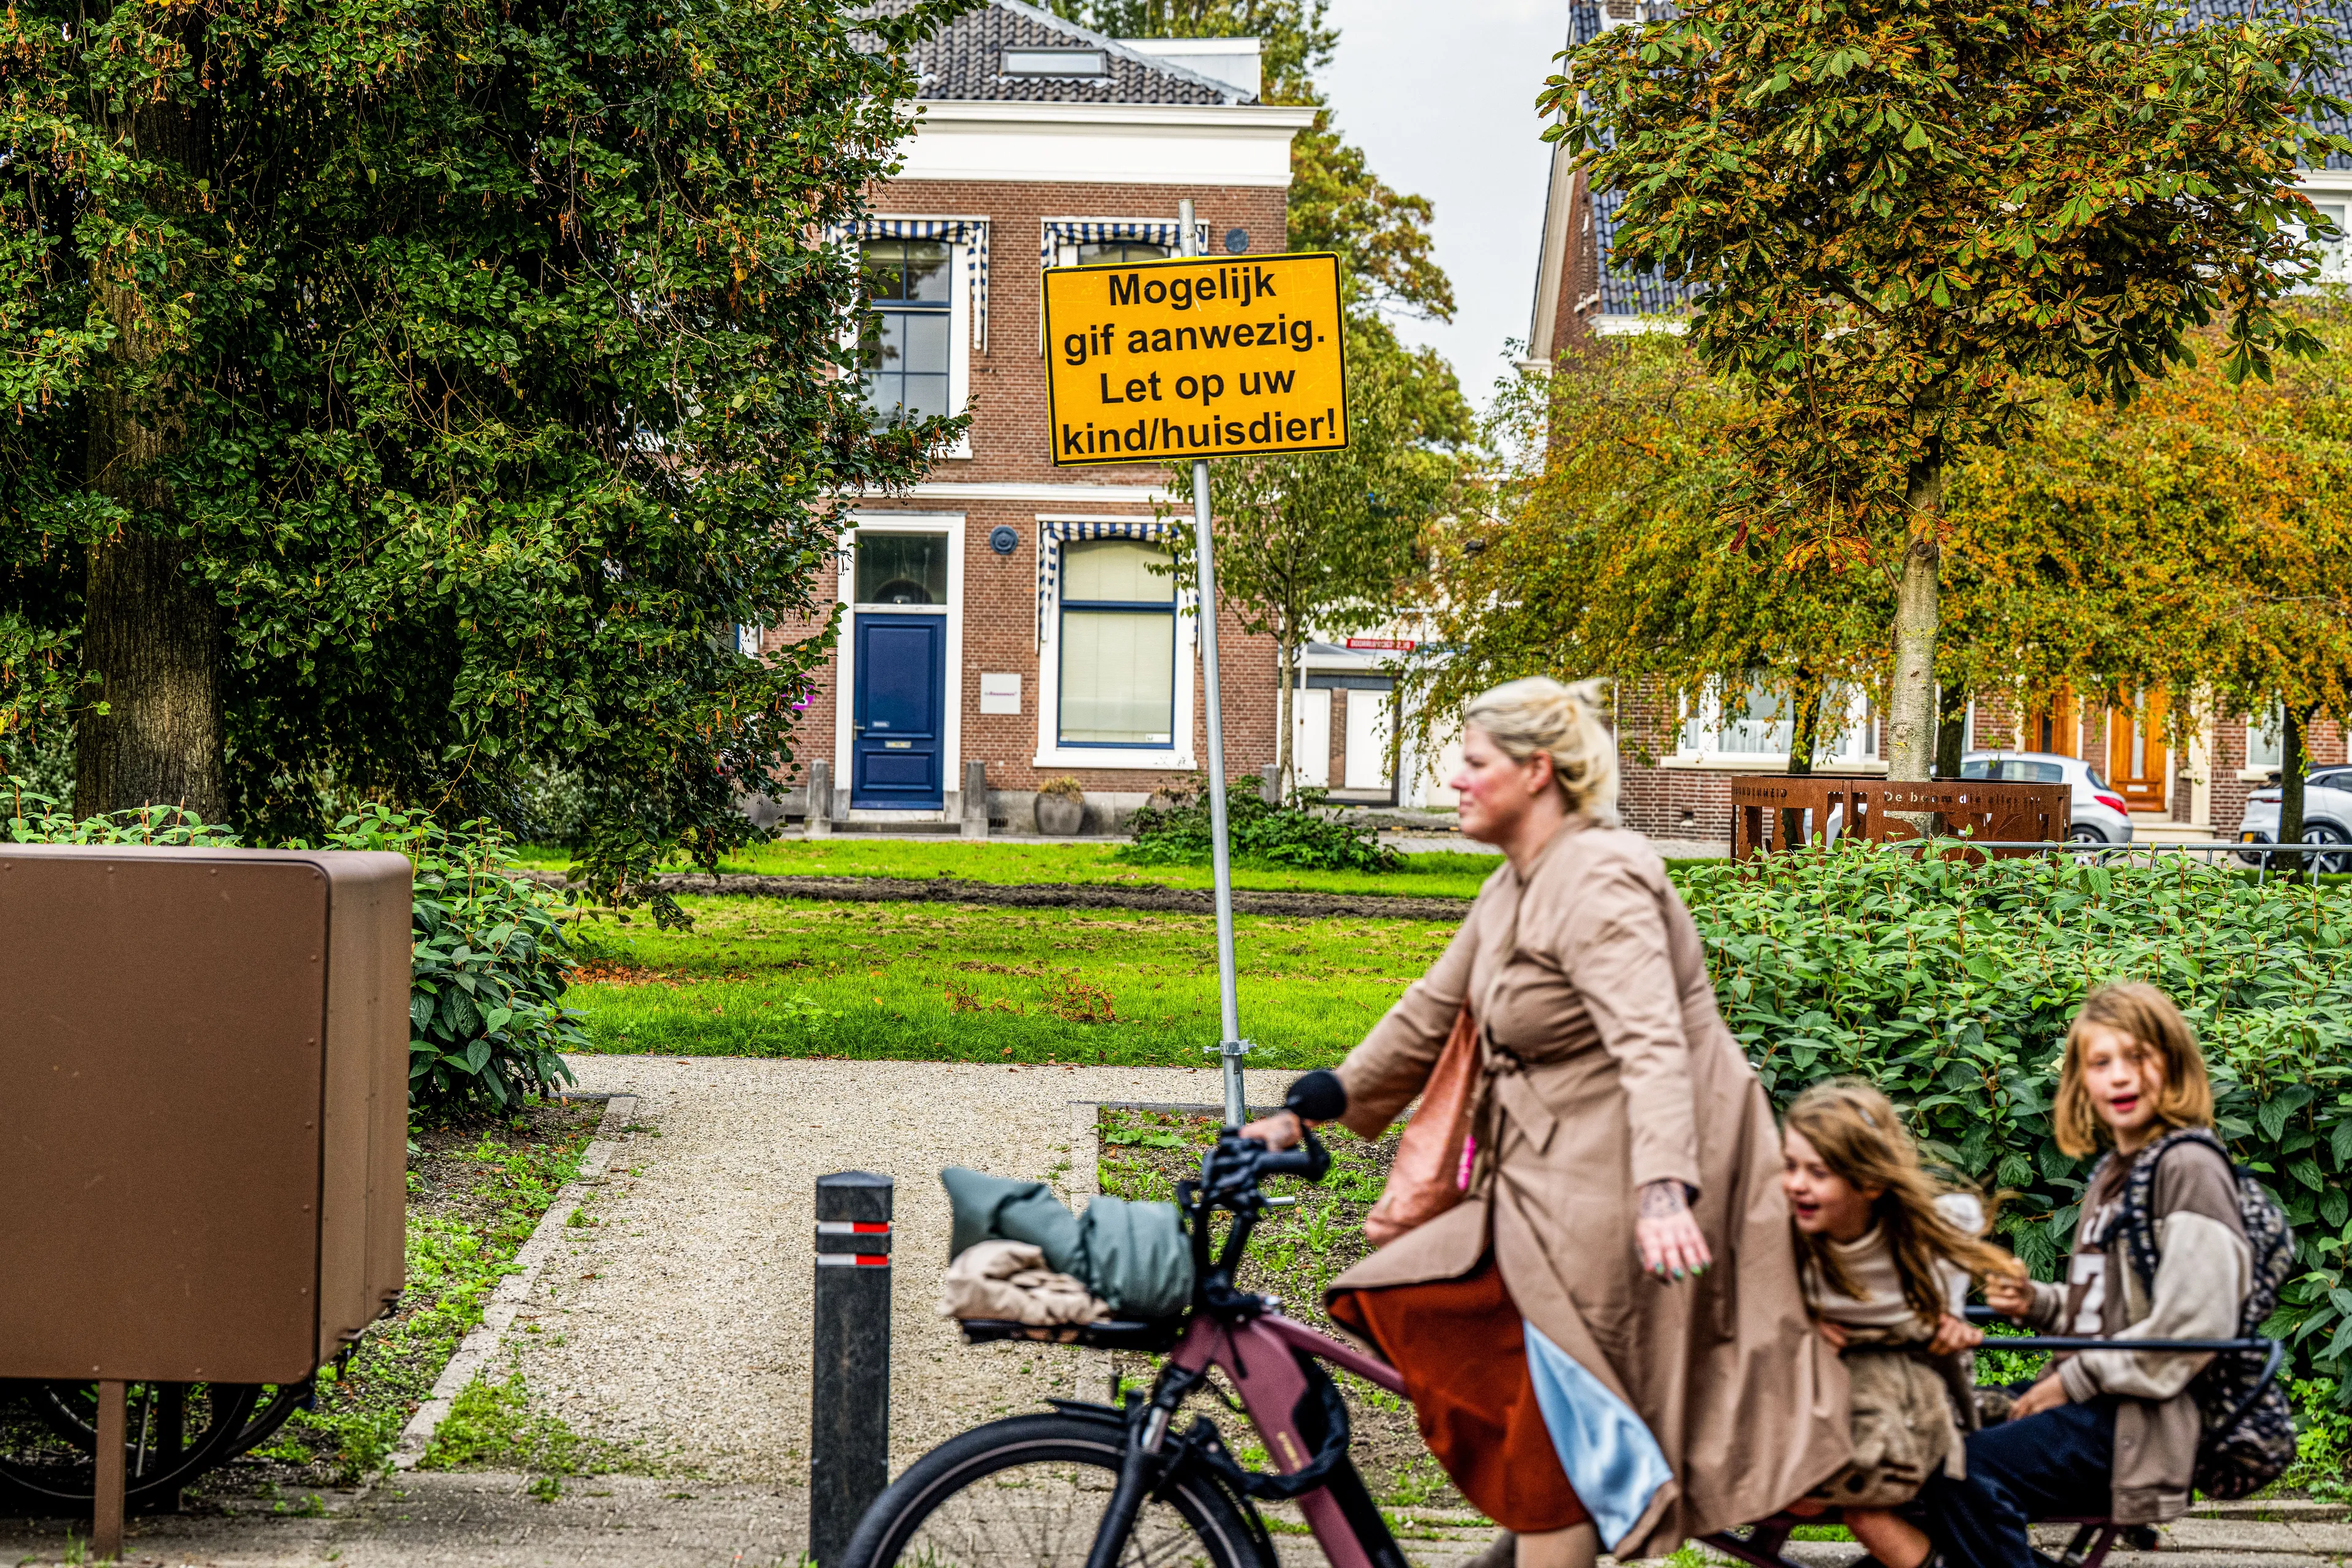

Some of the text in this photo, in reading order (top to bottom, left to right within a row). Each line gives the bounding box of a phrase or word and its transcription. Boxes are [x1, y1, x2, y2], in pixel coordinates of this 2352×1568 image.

[1109, 265, 1276, 311] Mogelijk
[1065, 313, 1324, 366] gif aanwezig.
[1101, 370, 1295, 406] Let op uw
[1063, 408, 1336, 455] kind/huisdier!
[1884, 791, 1902, 802] De
[1910, 792, 1952, 802] boom
[1959, 793, 1981, 804] die
